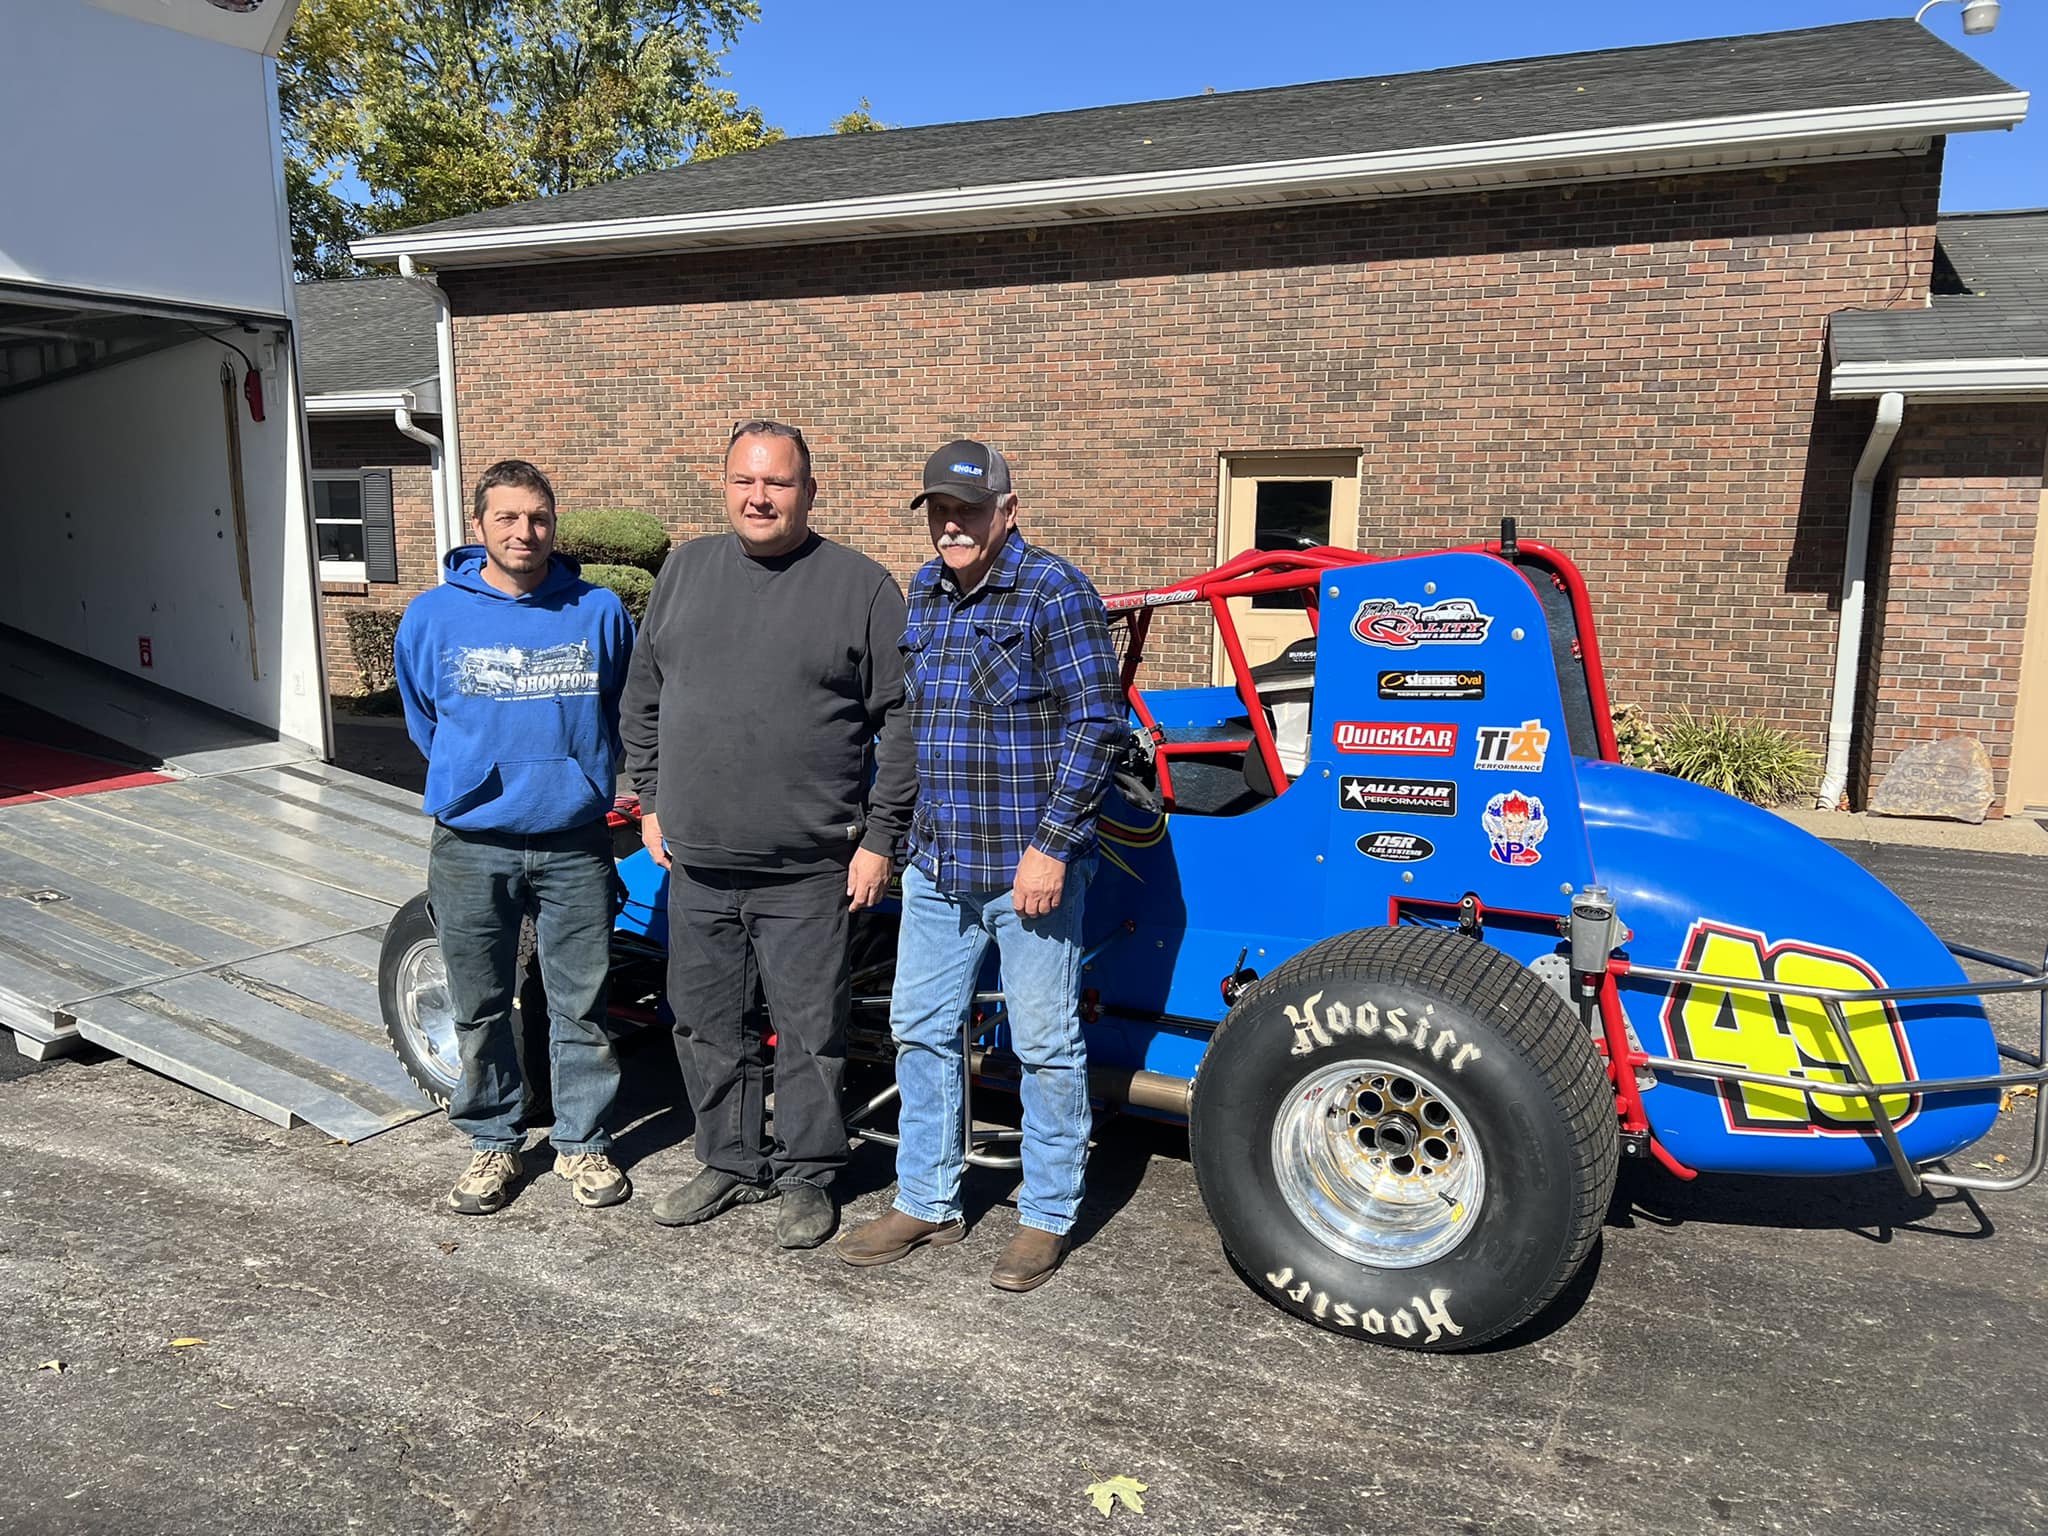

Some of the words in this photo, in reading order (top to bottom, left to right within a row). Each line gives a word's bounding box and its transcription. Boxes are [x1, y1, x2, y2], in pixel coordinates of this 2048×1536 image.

[954, 464, 982, 476] ENGLER
[1358, 615, 1481, 643] QUALITY
[516, 672, 600, 692] SHOOTOUT
[1475, 763, 1542, 772] PERFORMANCE
[1362, 783, 1451, 797] ALLSTAR
[1363, 795, 1450, 808] PERFORMANCE
[1373, 835, 1417, 849] DSR
[1494, 841, 1525, 864] VP
[1283, 990, 1482, 1070] Hoosier
[1670, 924, 1917, 1131] 49
[1266, 1267, 1464, 1344] Hoosier
